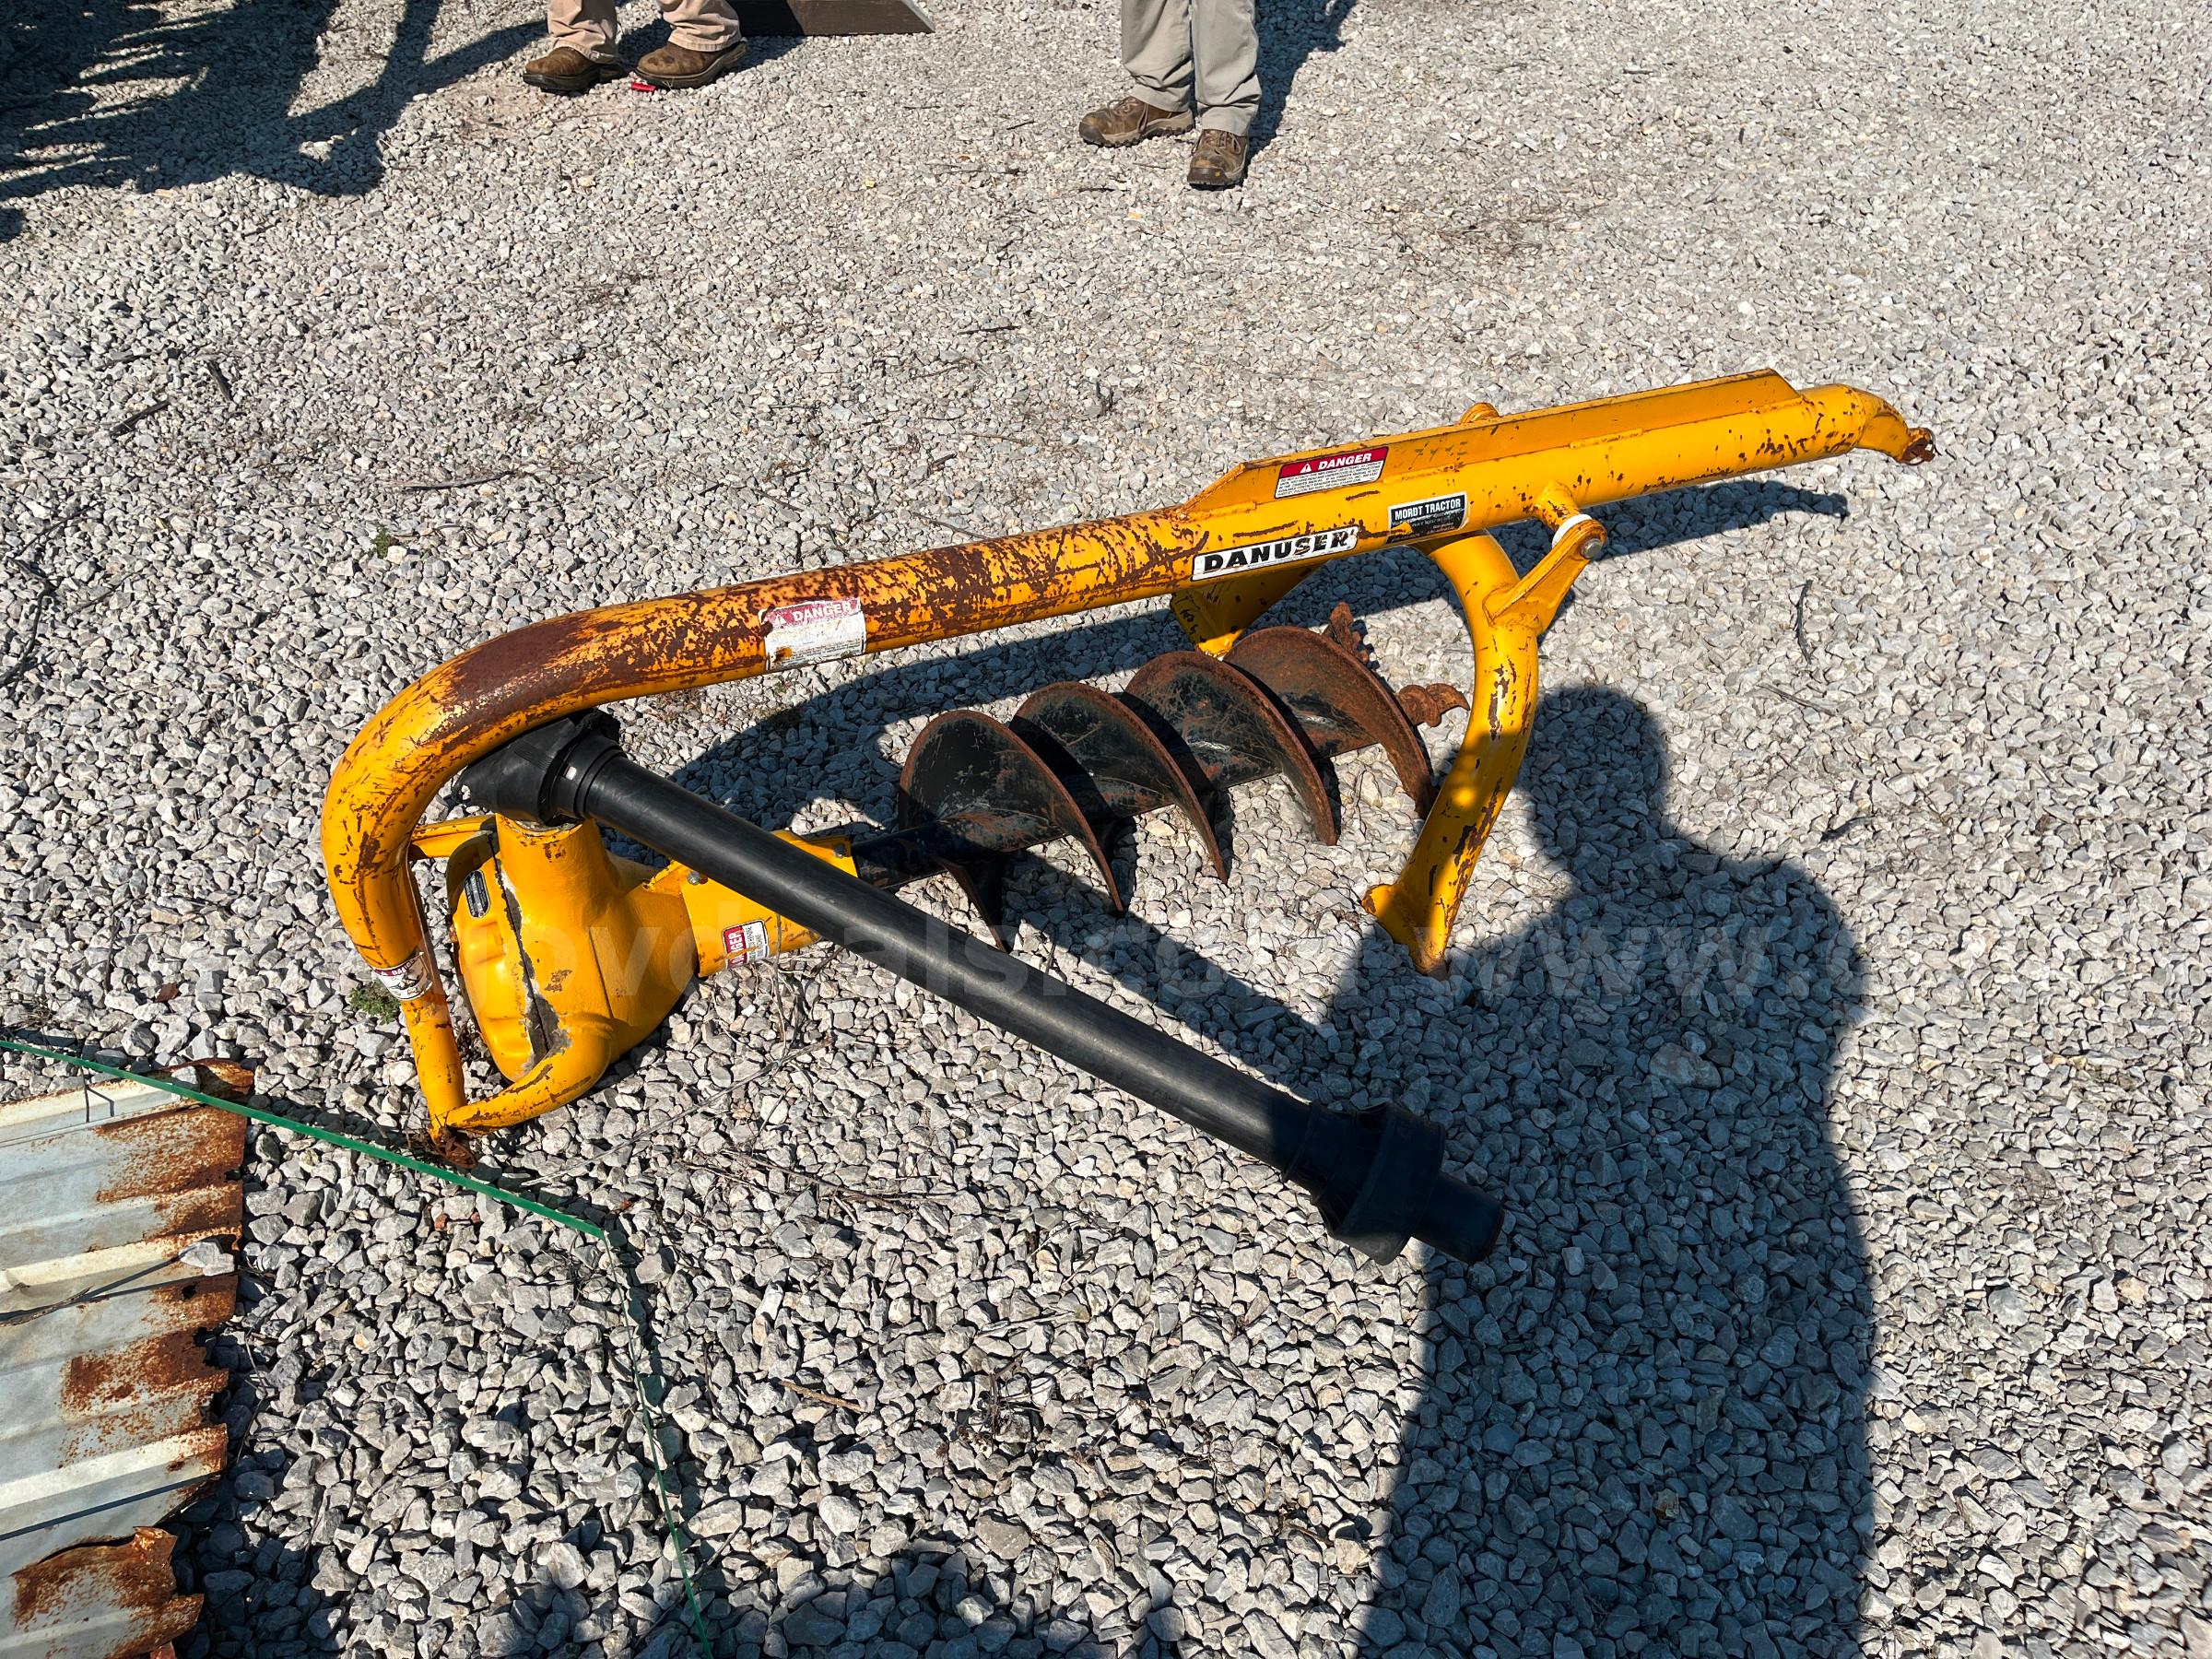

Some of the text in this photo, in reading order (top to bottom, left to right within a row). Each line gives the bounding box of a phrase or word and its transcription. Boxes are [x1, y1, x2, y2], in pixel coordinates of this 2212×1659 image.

[1318, 453, 1372, 471] DANGER
[1394, 498, 1462, 520] MORDT TRACTOR
[1204, 531, 1349, 573] DANUSER
[793, 600, 853, 623] DANGER
